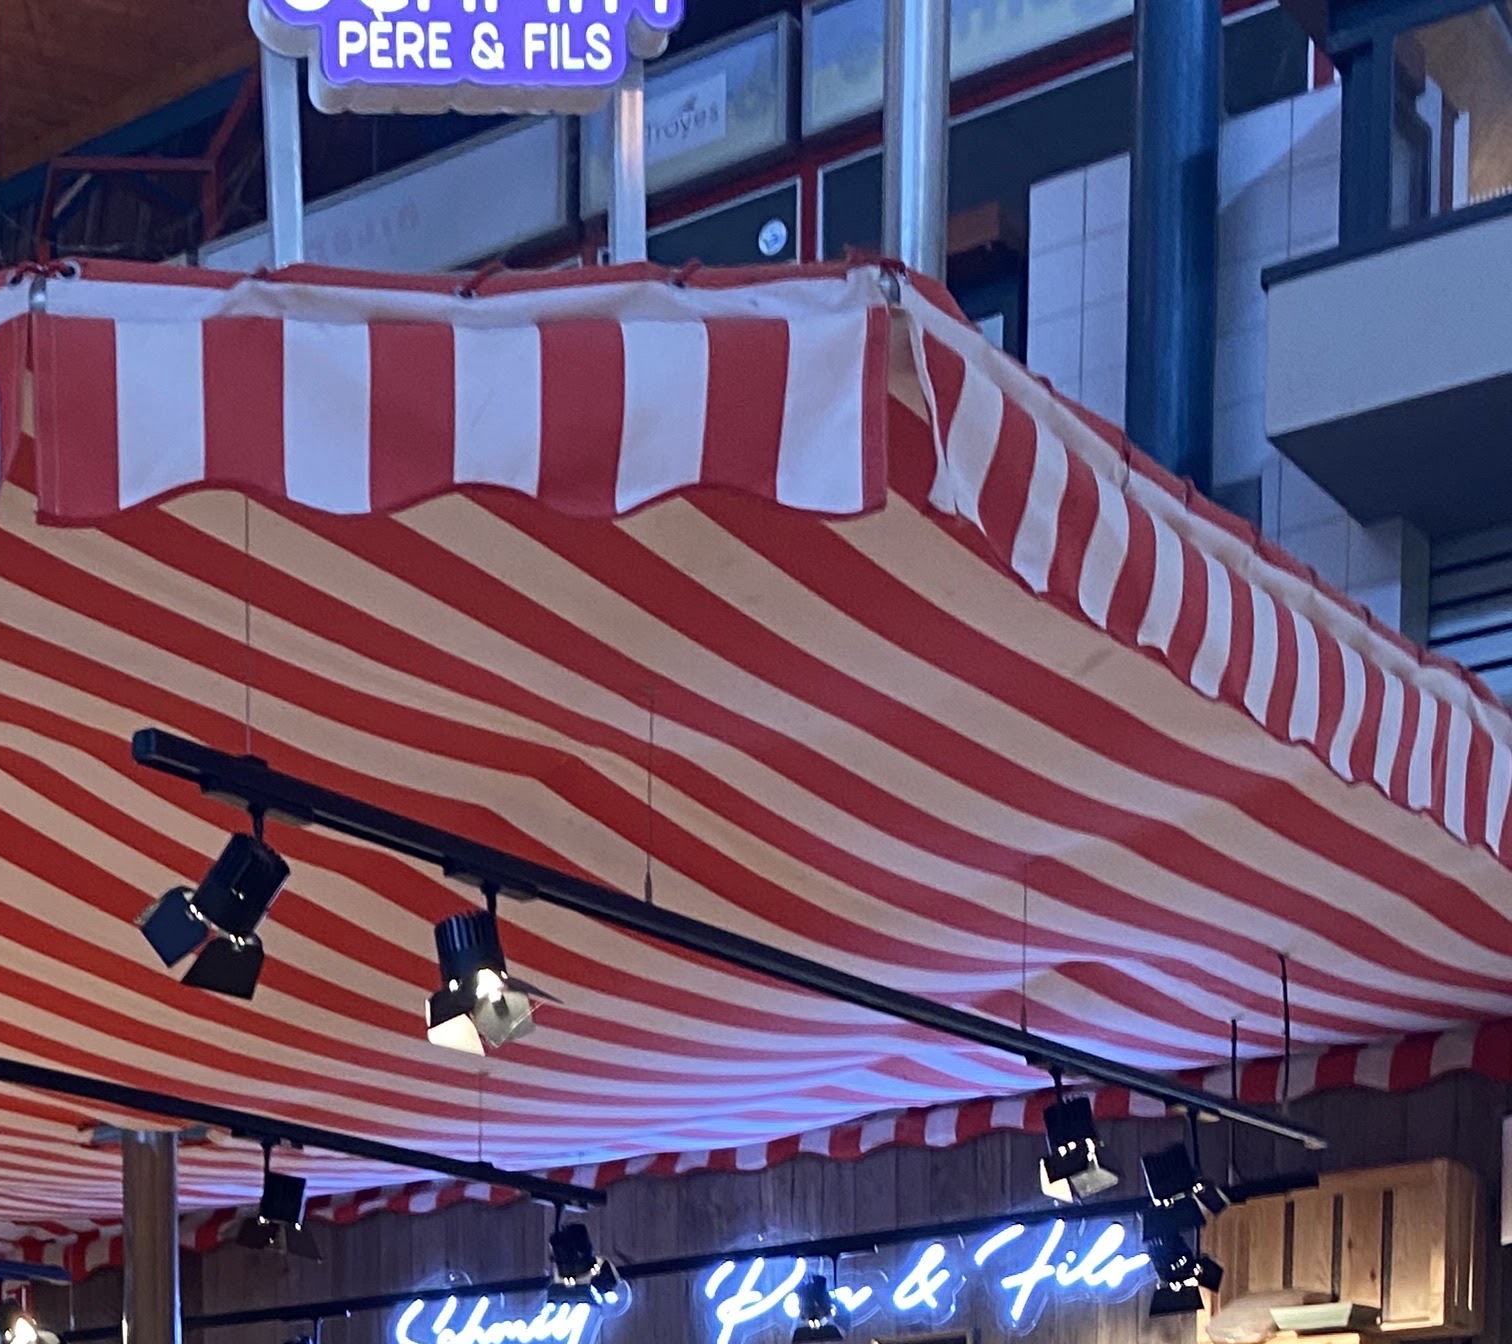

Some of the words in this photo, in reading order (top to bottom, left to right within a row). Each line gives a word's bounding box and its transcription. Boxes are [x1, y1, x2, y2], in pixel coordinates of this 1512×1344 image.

[470, 21, 505, 70] &
[524, 22, 613, 71] FILS
[893, 1243, 951, 1311] &
